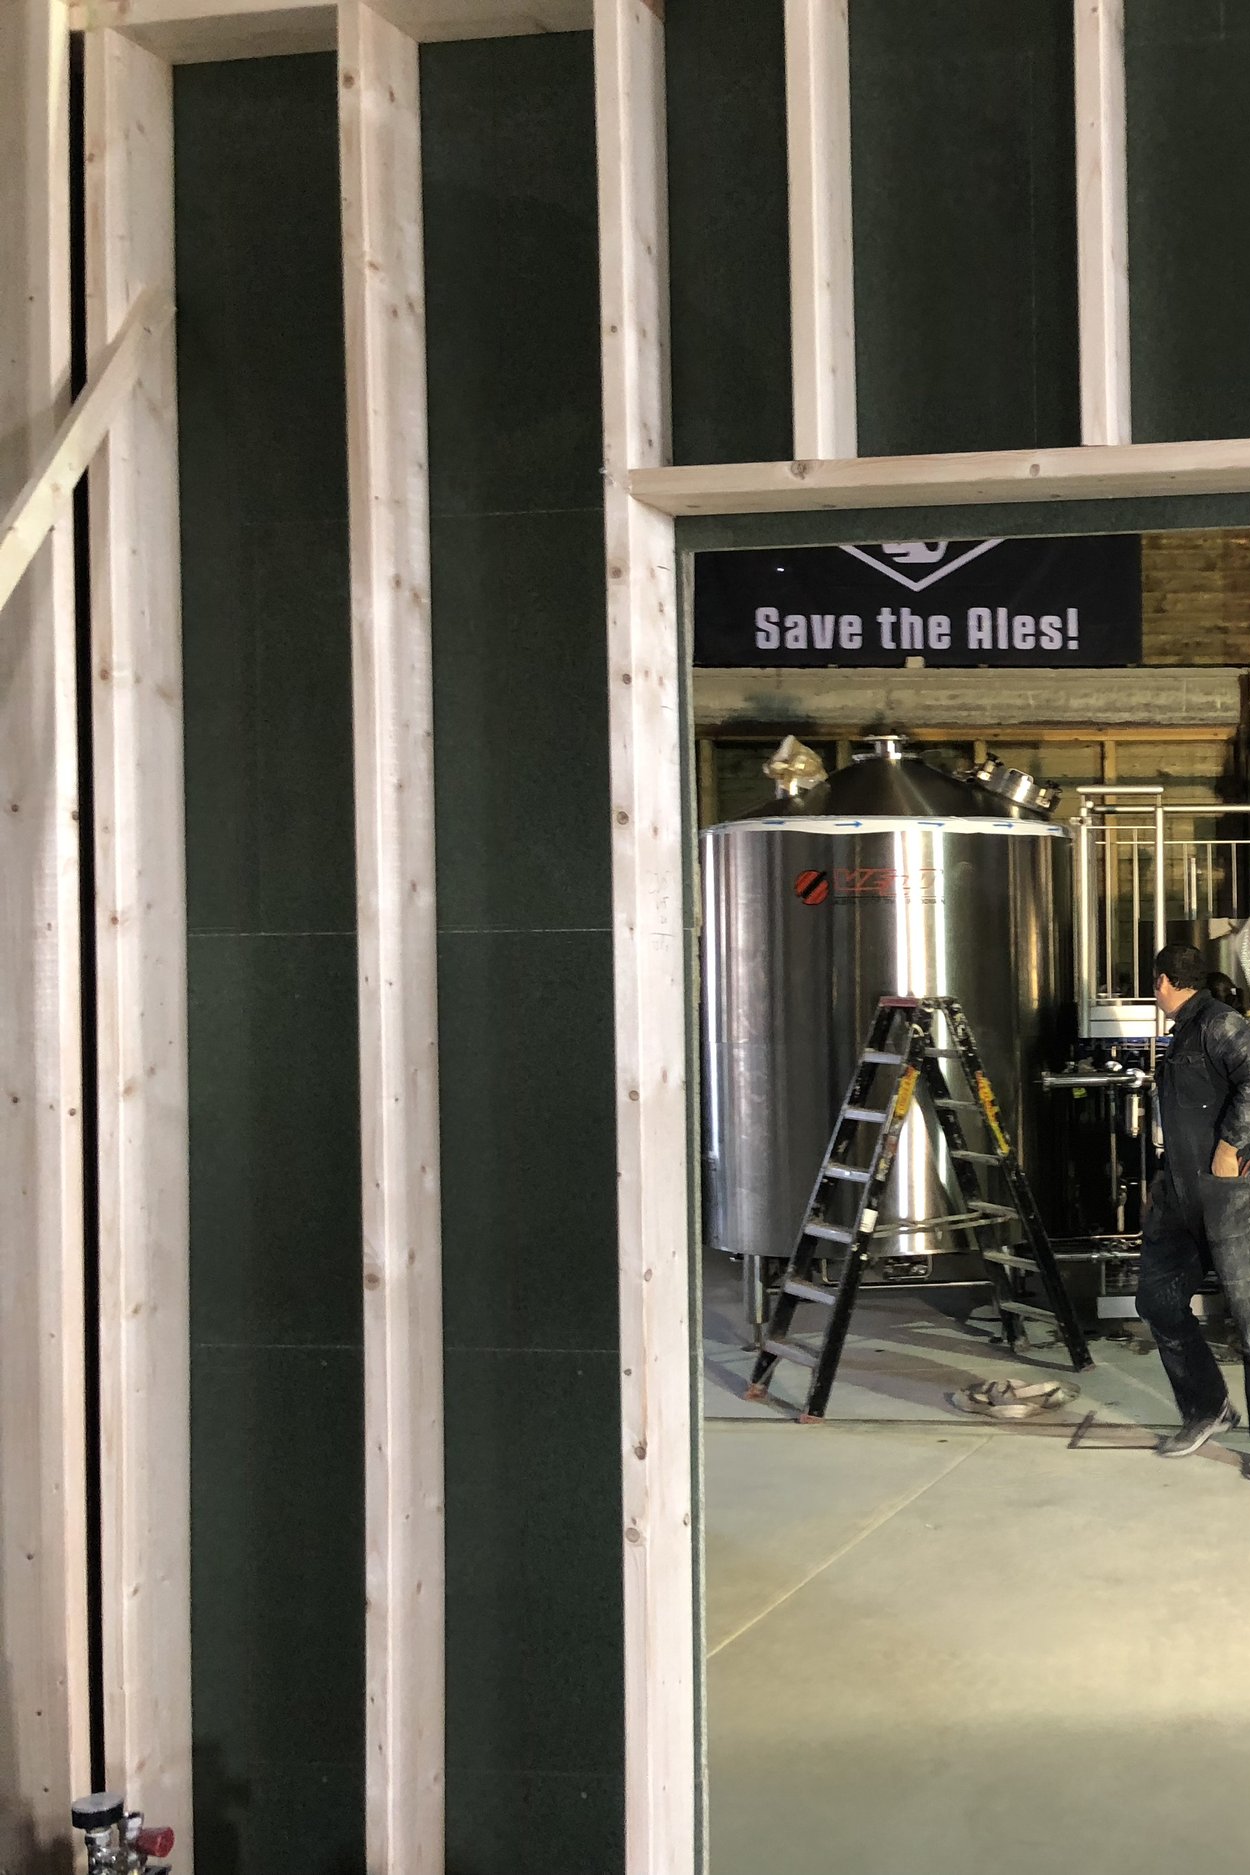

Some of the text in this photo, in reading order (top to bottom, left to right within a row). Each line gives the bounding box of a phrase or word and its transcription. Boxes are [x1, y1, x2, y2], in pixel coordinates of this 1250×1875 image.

[755, 606, 1079, 650] Save the Ales!
